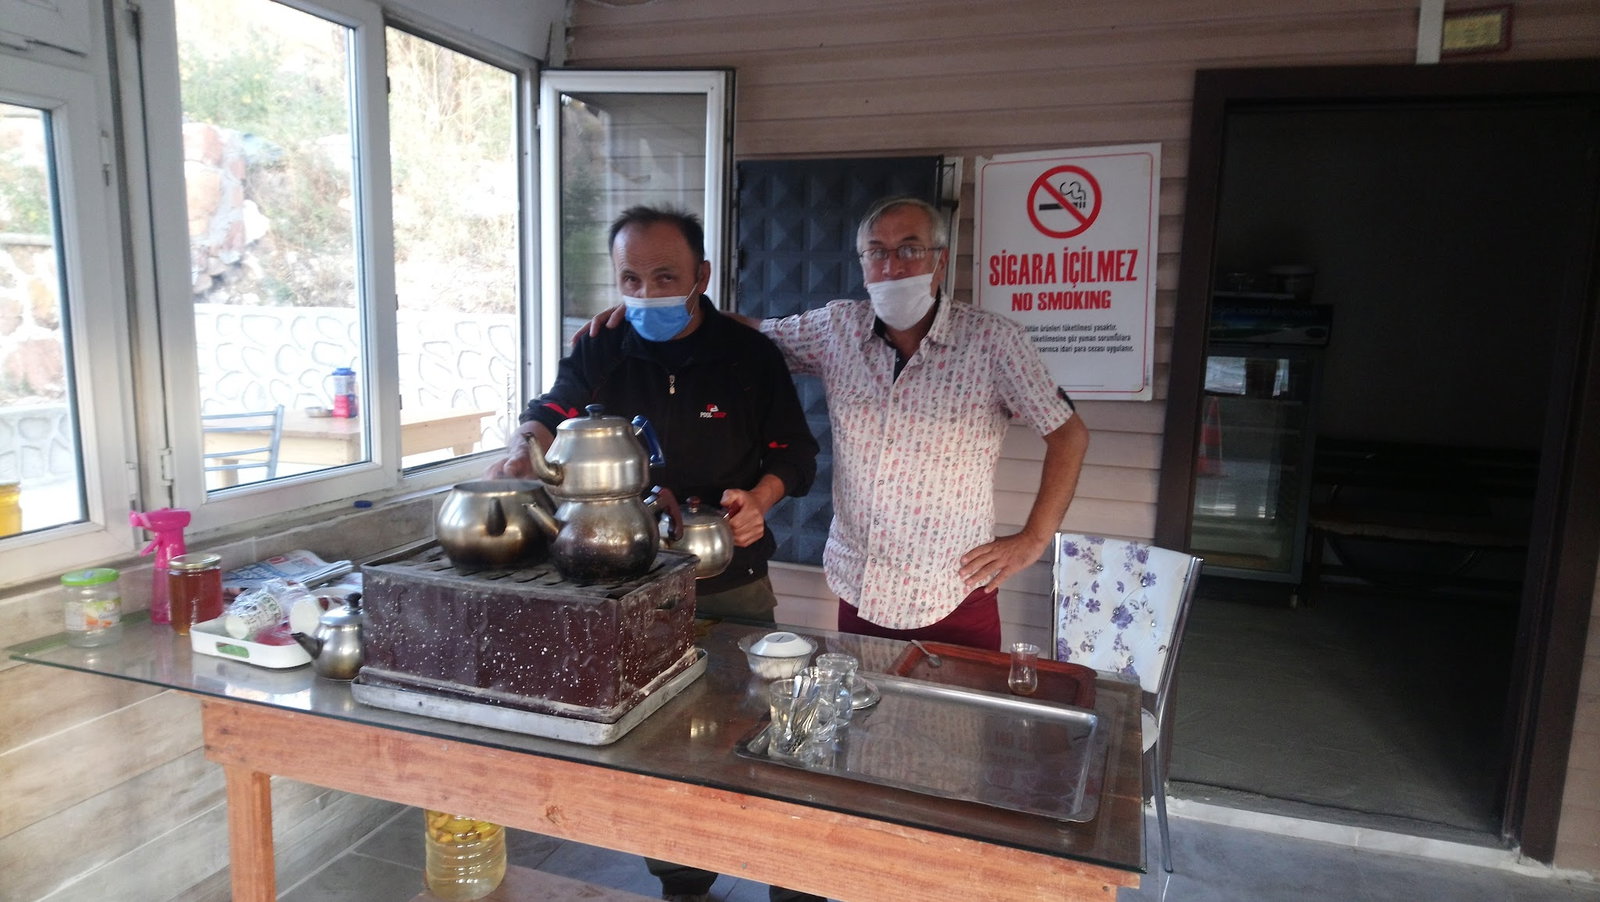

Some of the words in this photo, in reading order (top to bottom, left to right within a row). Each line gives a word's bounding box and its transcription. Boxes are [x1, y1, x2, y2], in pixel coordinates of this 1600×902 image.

[989, 249, 1057, 286] SİGARA
[1062, 246, 1138, 288] İÇİLMEZ
[1011, 292, 1033, 311] NO
[1037, 290, 1112, 311] SMOKING
[1079, 335, 1097, 343] yuman
